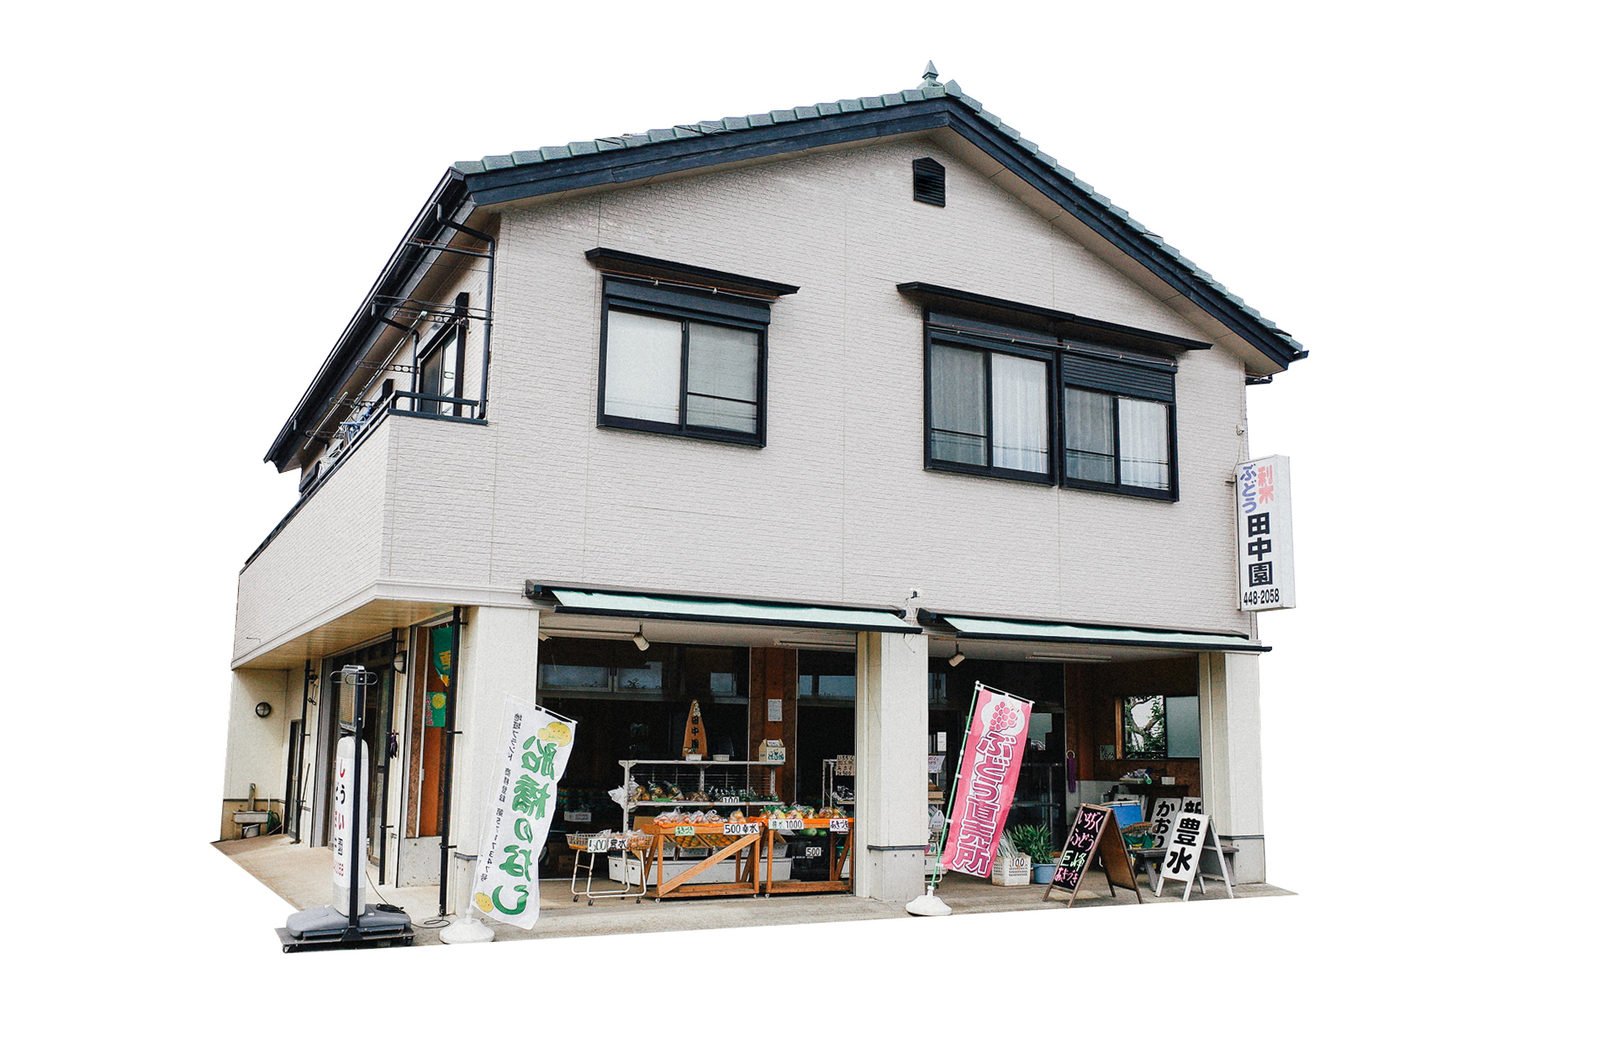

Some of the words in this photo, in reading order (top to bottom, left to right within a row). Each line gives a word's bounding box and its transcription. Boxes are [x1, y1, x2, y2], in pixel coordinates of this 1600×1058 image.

[1240, 464, 1257, 514] ぶどう
[1247, 512, 1273, 587] 田中園
[1243, 588, 1279, 605] 448-2058
[724, 824, 741, 834] 500
[952, 730, 1017, 878] ぶどう直売所
[1166, 818, 1202, 874] 豊水
